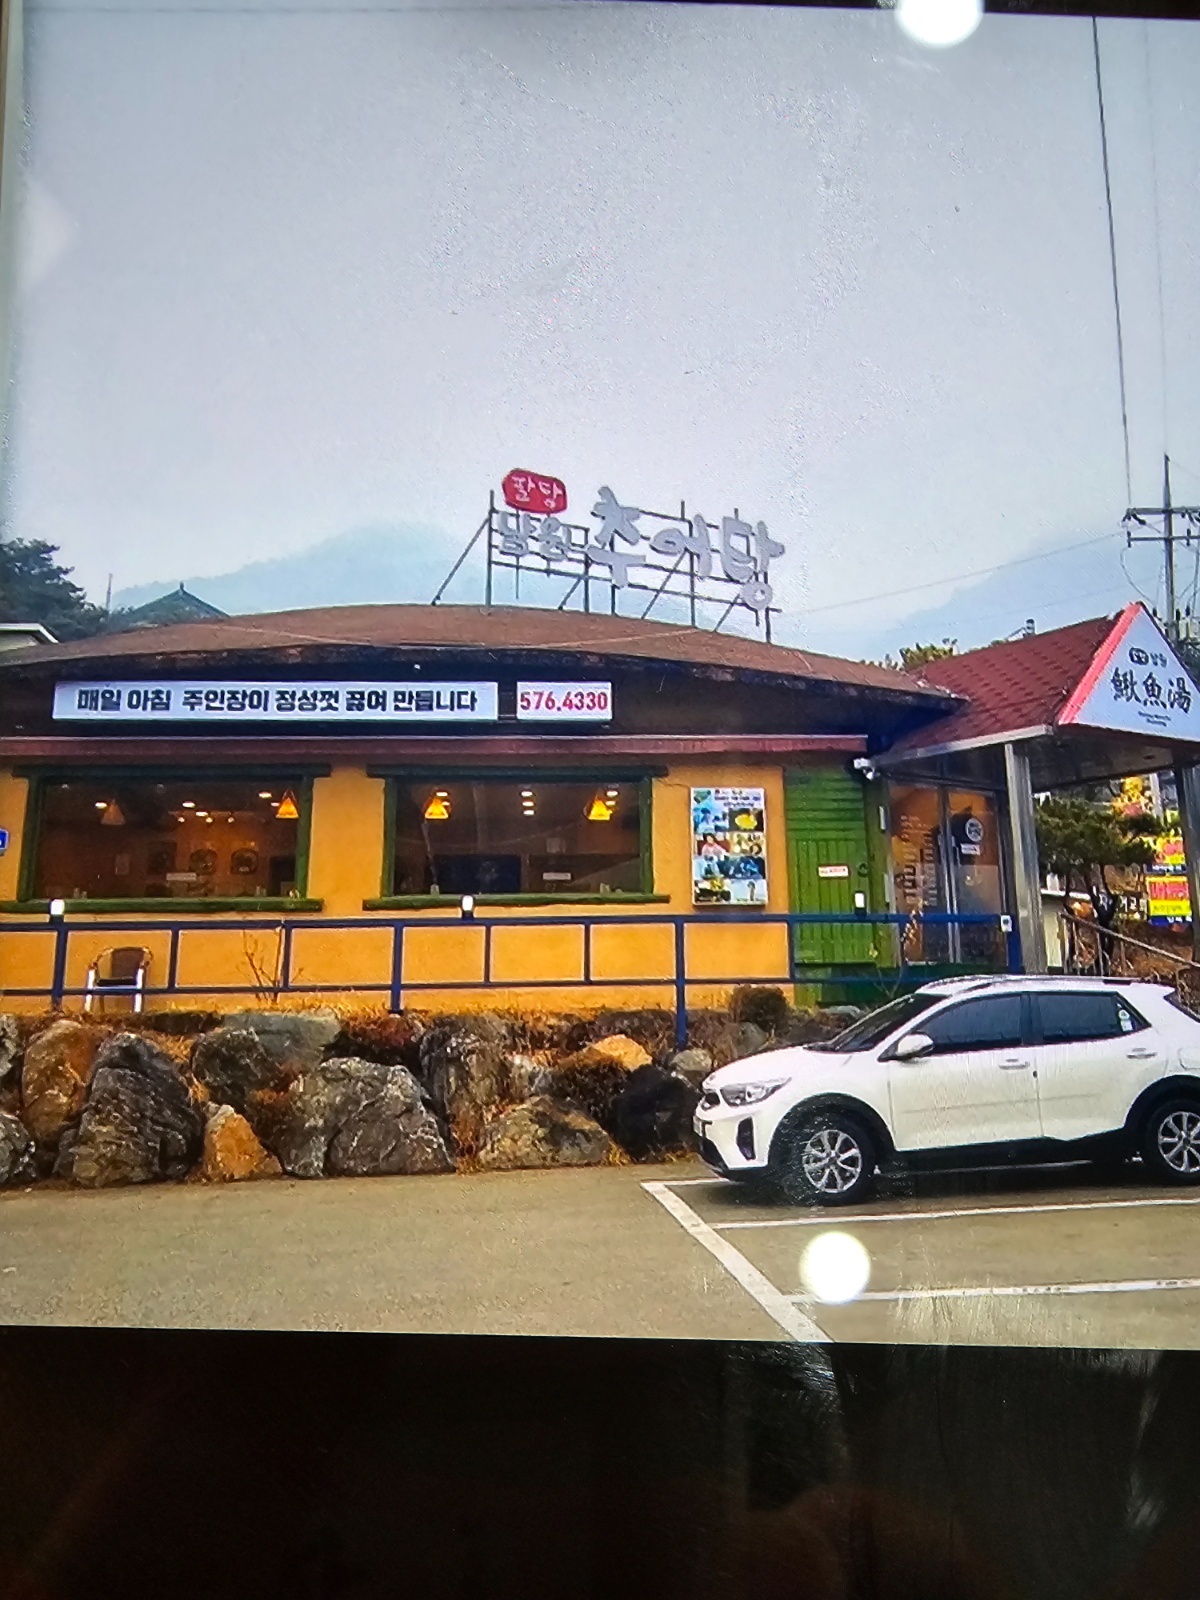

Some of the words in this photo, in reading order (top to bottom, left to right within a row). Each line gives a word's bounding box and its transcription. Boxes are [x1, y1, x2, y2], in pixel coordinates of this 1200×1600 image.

[585, 486, 785, 610] 추어탕
[77, 688, 121, 711] 매일
[127, 690, 171, 711] 아침
[182, 689, 269, 712] 주인장이
[275, 690, 339, 711] 정성껏
[345, 690, 387, 712] 끓여
[393, 690, 478, 712] 만듭니다
[519, 691, 608, 712] 576.4330
